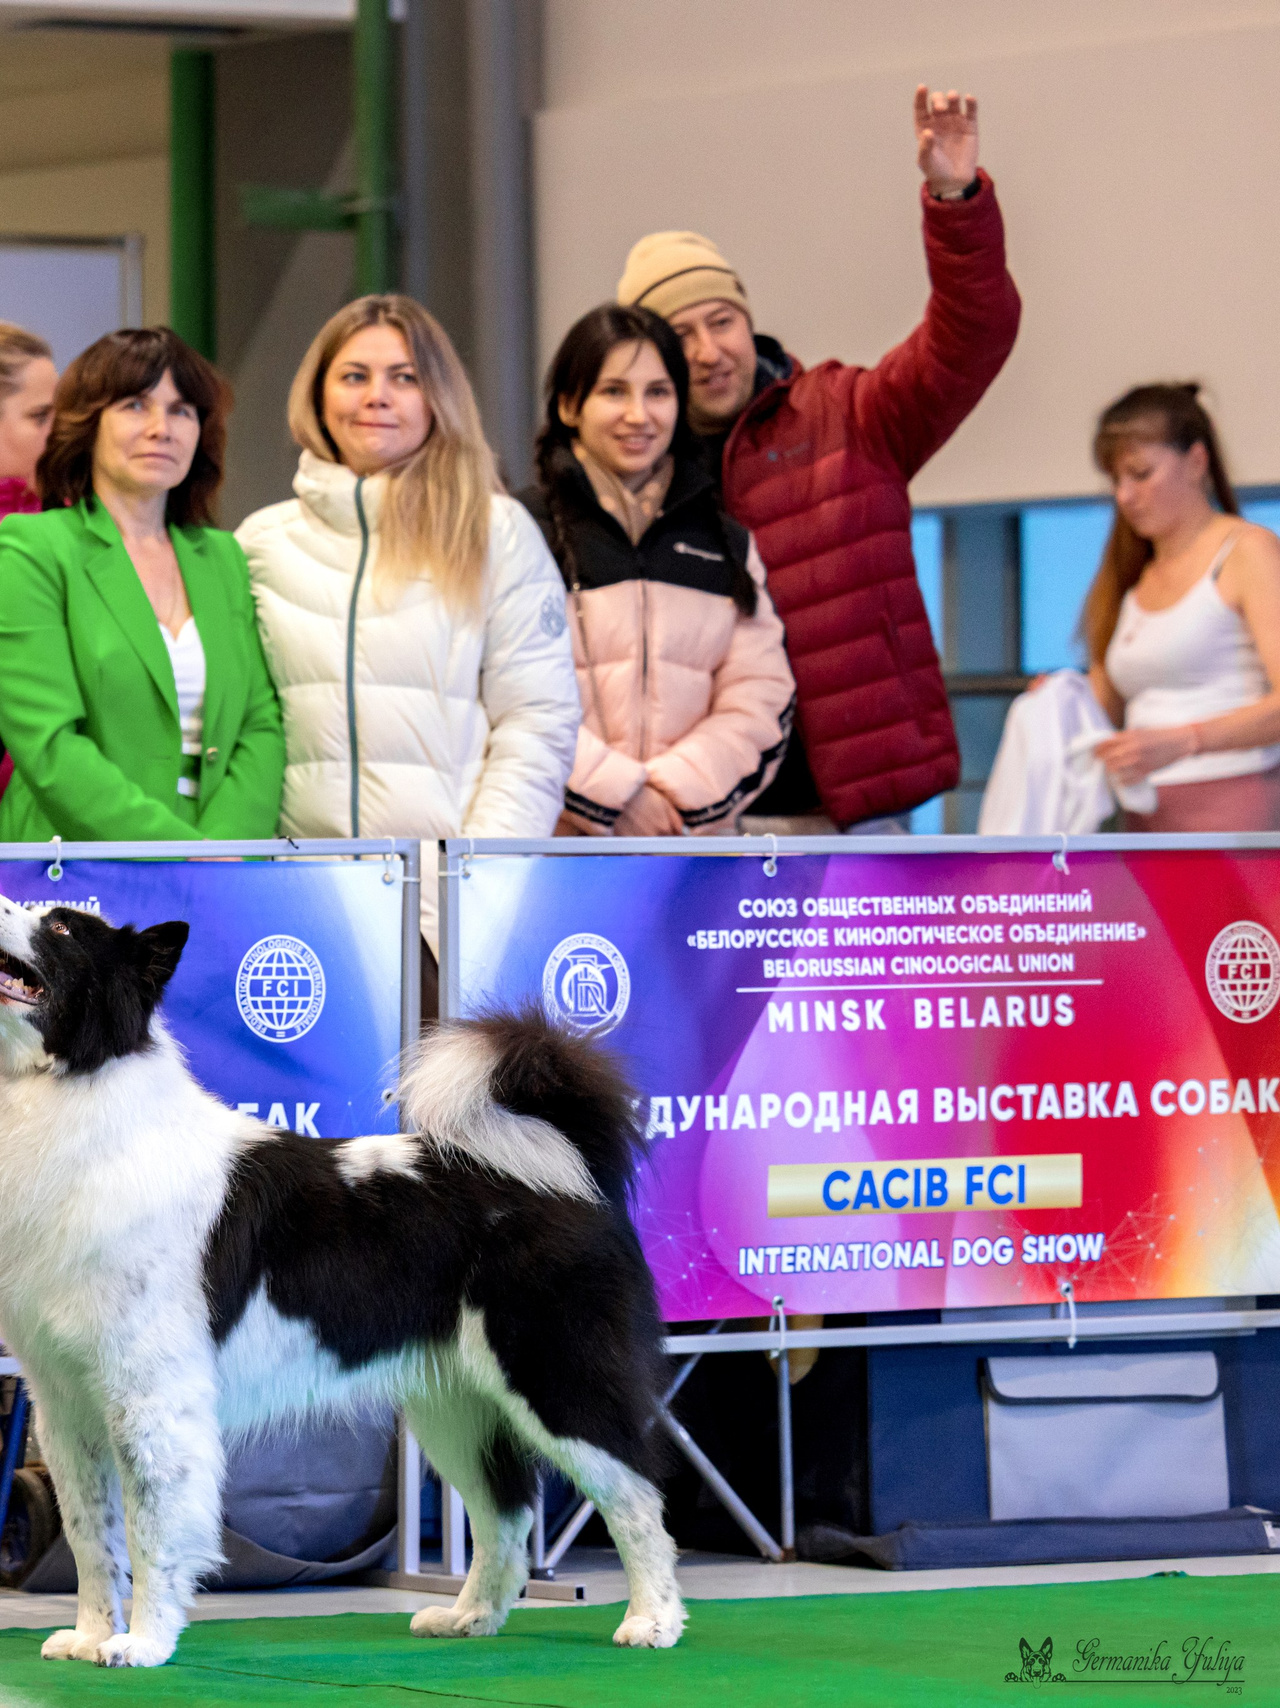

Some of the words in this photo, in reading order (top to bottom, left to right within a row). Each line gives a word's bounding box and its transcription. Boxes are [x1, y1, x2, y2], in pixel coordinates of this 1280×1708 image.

[738, 898, 798, 918] СОЮЗ
[802, 896, 956, 919] ОБЩЕСТВЕННЫХ
[961, 889, 1093, 916] ОБЪЕДИНЕНИЙ
[687, 928, 829, 950] «БЕЛОРУССКОЕ
[833, 924, 1004, 948] КИНОЛОГИЧЕСКОЕ
[1009, 922, 1147, 946] ОБЪЕДИНЕНИЕ»
[763, 956, 886, 978] BELORUSSIAN
[890, 954, 1014, 976] CINOLOGICAL
[1018, 953, 1075, 973] UNION
[1228, 964, 1260, 980] FCI
[262, 980, 299, 997] FCI
[768, 998, 886, 1033] MINSK
[914, 993, 1075, 1030] BELARUS
[933, 1081, 1140, 1123] ВЫСТАВКА
[1150, 1077, 1280, 1117] СОБАК
[822, 1168, 949, 1212] CACIB
[965, 1164, 1026, 1205] FCI
[738, 1239, 945, 1276] INTERNATIONAL
[952, 1236, 1015, 1268] DOG
[1021, 1233, 1105, 1265] SHOW
